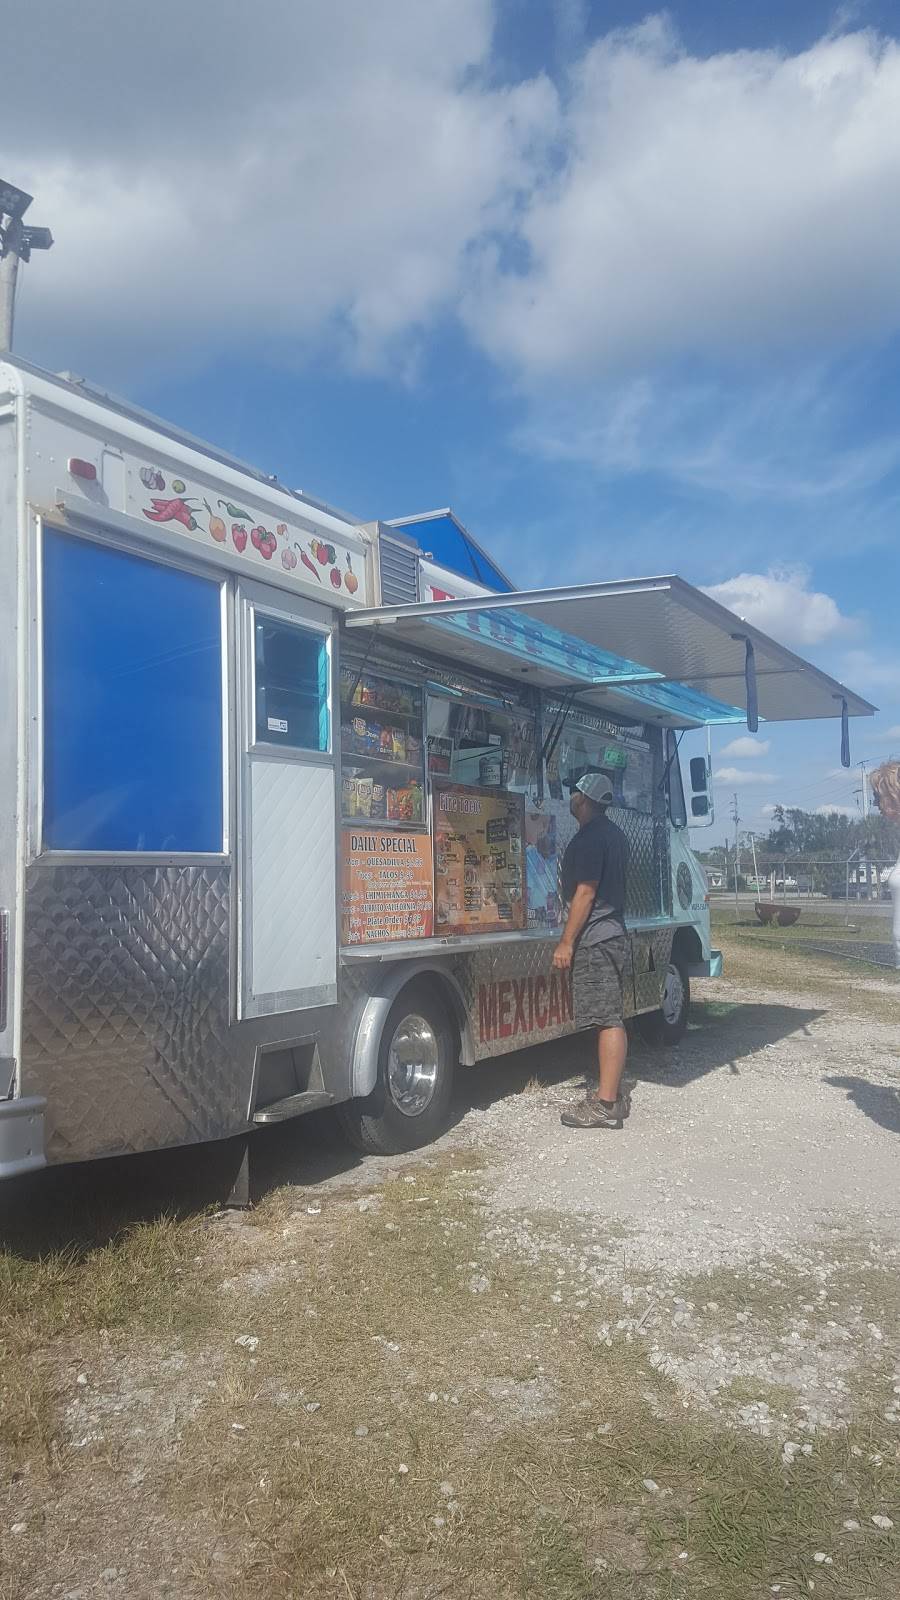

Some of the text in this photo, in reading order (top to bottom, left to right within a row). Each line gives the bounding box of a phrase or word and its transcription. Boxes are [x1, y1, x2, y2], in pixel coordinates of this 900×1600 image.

[351, 836, 417, 852] DAILY SPECIAL
[367, 857, 404, 867] QUESADILLA
[379, 871, 399, 880] TACOS
[361, 904, 384, 913] BURRITO
[385, 902, 416, 912] CALIFORNIA
[368, 917, 383, 926] Plate
[384, 916, 402, 925] Order
[366, 930, 390, 938] NACHOS
[478, 970, 574, 1042] MEXICAN
